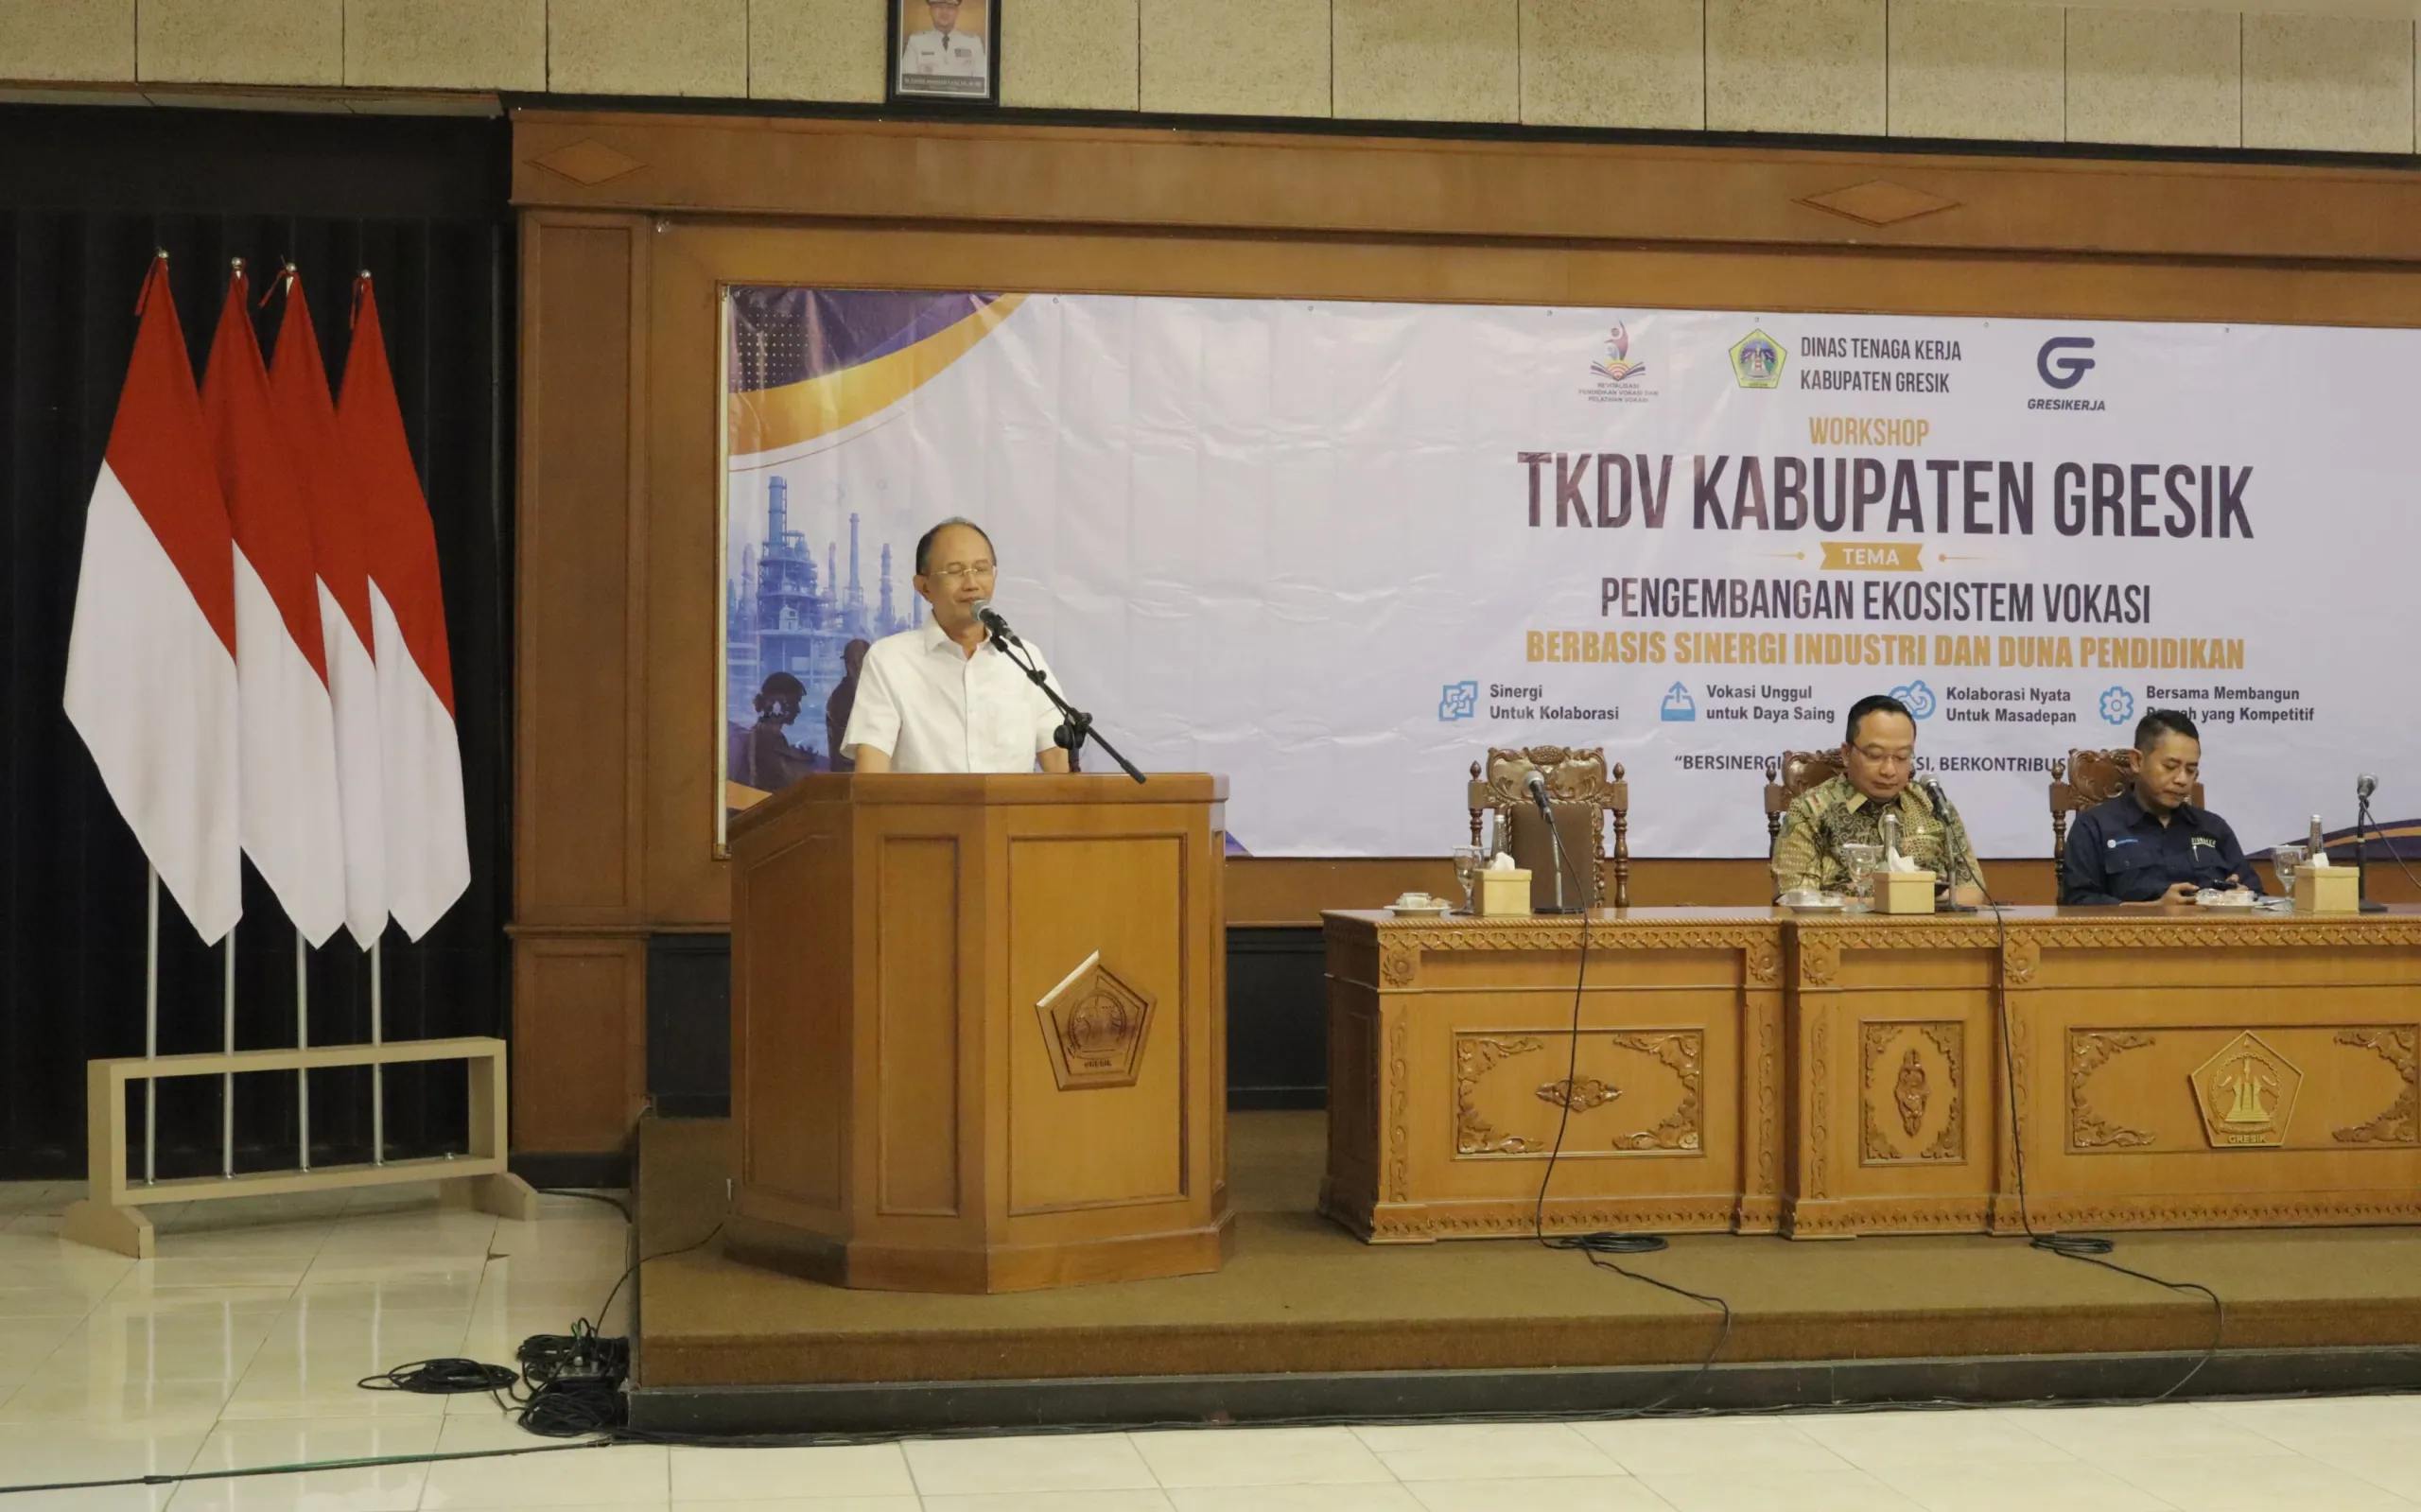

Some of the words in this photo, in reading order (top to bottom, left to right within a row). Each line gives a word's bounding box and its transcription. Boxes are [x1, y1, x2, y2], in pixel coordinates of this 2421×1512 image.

[1801, 336, 1848, 358] DINAS
[1850, 338, 1911, 360] TENAGA
[1914, 339, 1962, 361] KERJA
[1801, 369, 1891, 392] KABUPATEN
[1895, 372, 1950, 393] GRESIK
[2027, 398, 2106, 411] GRESIKERJA
[1809, 416, 1929, 447] WORKSHOP
[1517, 451, 1674, 529] TKDV
[1693, 455, 2033, 536] KABUPATEN
[2053, 461, 2255, 539] GRESIK
[1842, 547, 1900, 565] TEMA
[1601, 577, 1854, 620] PENGEMBANGAN
[1863, 581, 2033, 622] EKOSISTEM
[2043, 583, 2151, 624] VOKASI
[1526, 631, 1666, 664] BERBASIS
[1674, 632, 1787, 665] SINERGI
[1794, 633, 1926, 667] INDUSTRI
[1934, 634, 1991, 667] DAN
[1998, 635, 2074, 668] DUNA
[2080, 636, 2244, 669] PENDIDIKAN
[1489, 684, 1542, 702] Sinergi
[1706, 684, 1756, 699] Vokasi
[1761, 685, 1812, 703] Unggul
[1946, 686, 2026, 702] Kolaborasi
[2029, 687, 2071, 705] Nyata
[2146, 685, 2210, 700] Bersama
[2214, 686, 2300, 704] Membangun
[1489, 705, 1535, 720] Untuk
[1540, 705, 1619, 721] Kolaborasi
[1706, 705, 1749, 721] untuk
[1752, 705, 1789, 723] Daya
[1793, 705, 1836, 724] Saing
[1946, 707, 1991, 722] Untuk
[1994, 707, 2077, 726] Masadepan
[2201, 709, 2235, 724] yang
[2239, 706, 2315, 724] Kompetitif
[1940, 756, 2067, 773] BERKONTRIBUS
[2228, 1135, 2267, 1143] GRESIK
